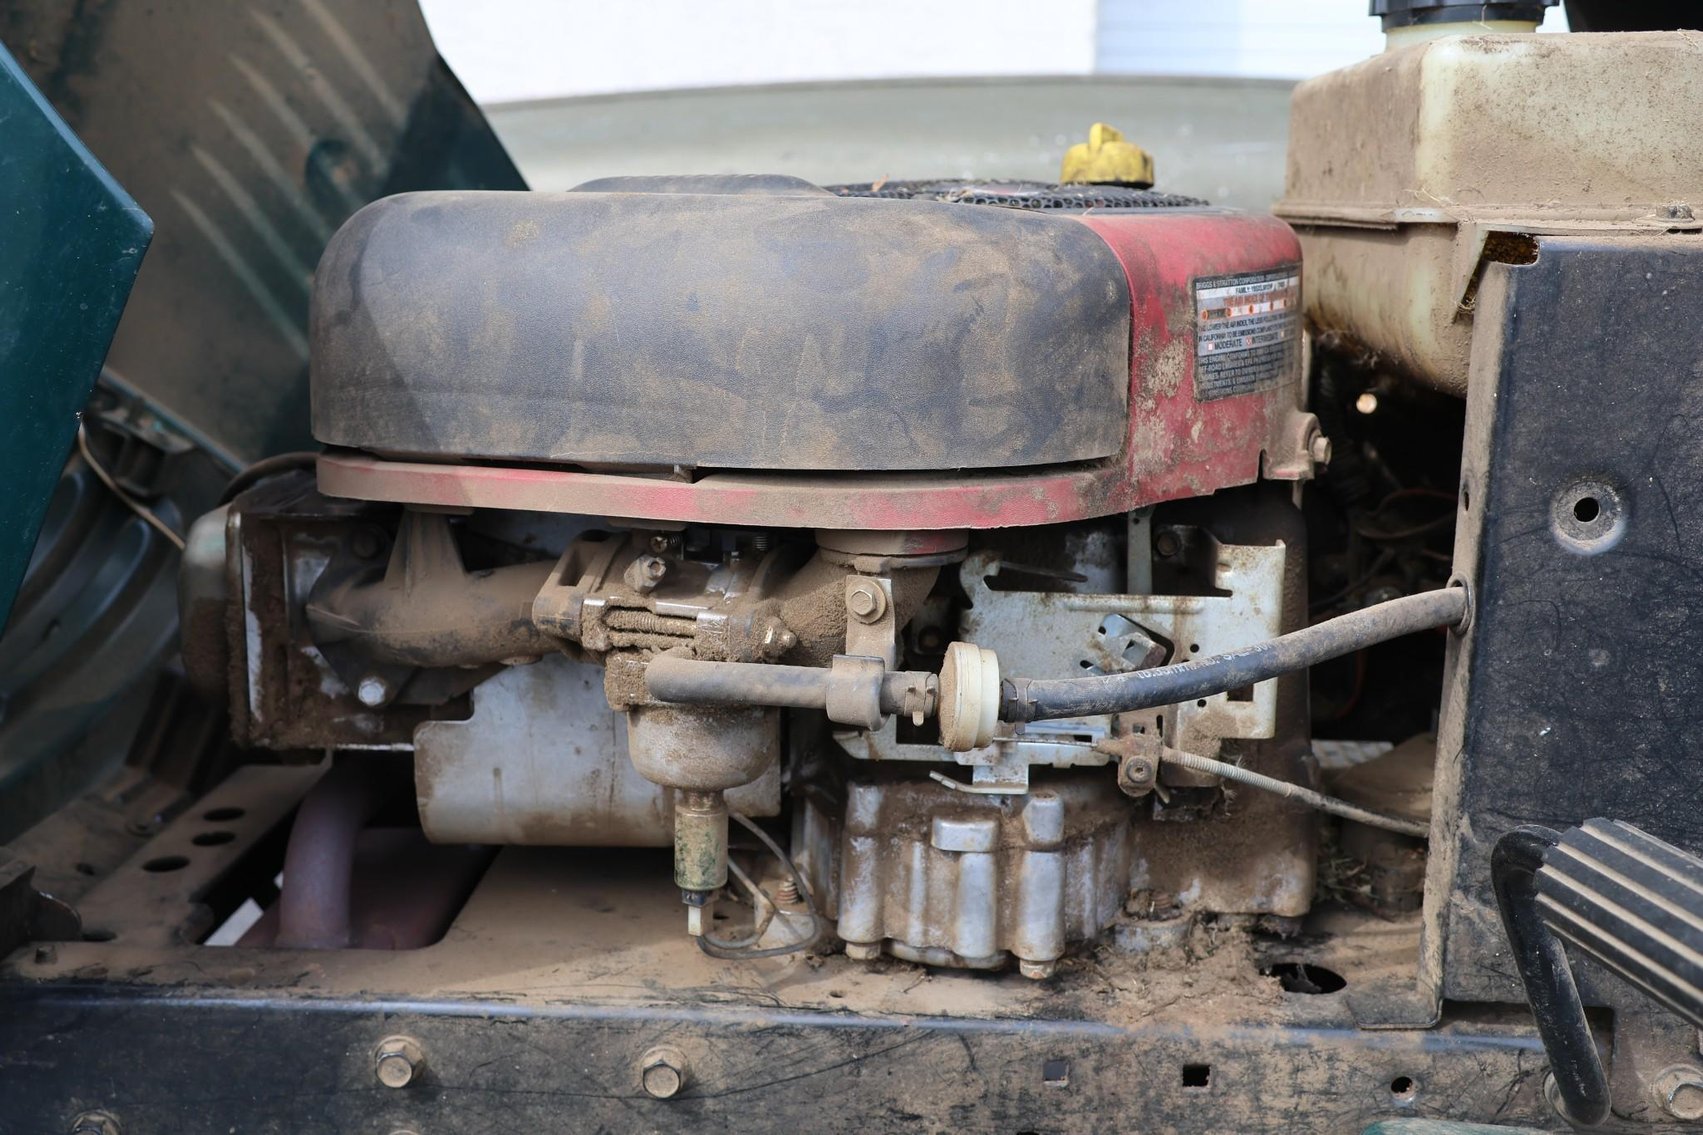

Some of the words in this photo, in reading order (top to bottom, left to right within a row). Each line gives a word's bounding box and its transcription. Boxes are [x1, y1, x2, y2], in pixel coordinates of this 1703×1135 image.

[1195, 281, 1212, 289] BRIGGS
[1216, 277, 1238, 287] STRATTON
[1213, 338, 1242, 350] MODERATE
